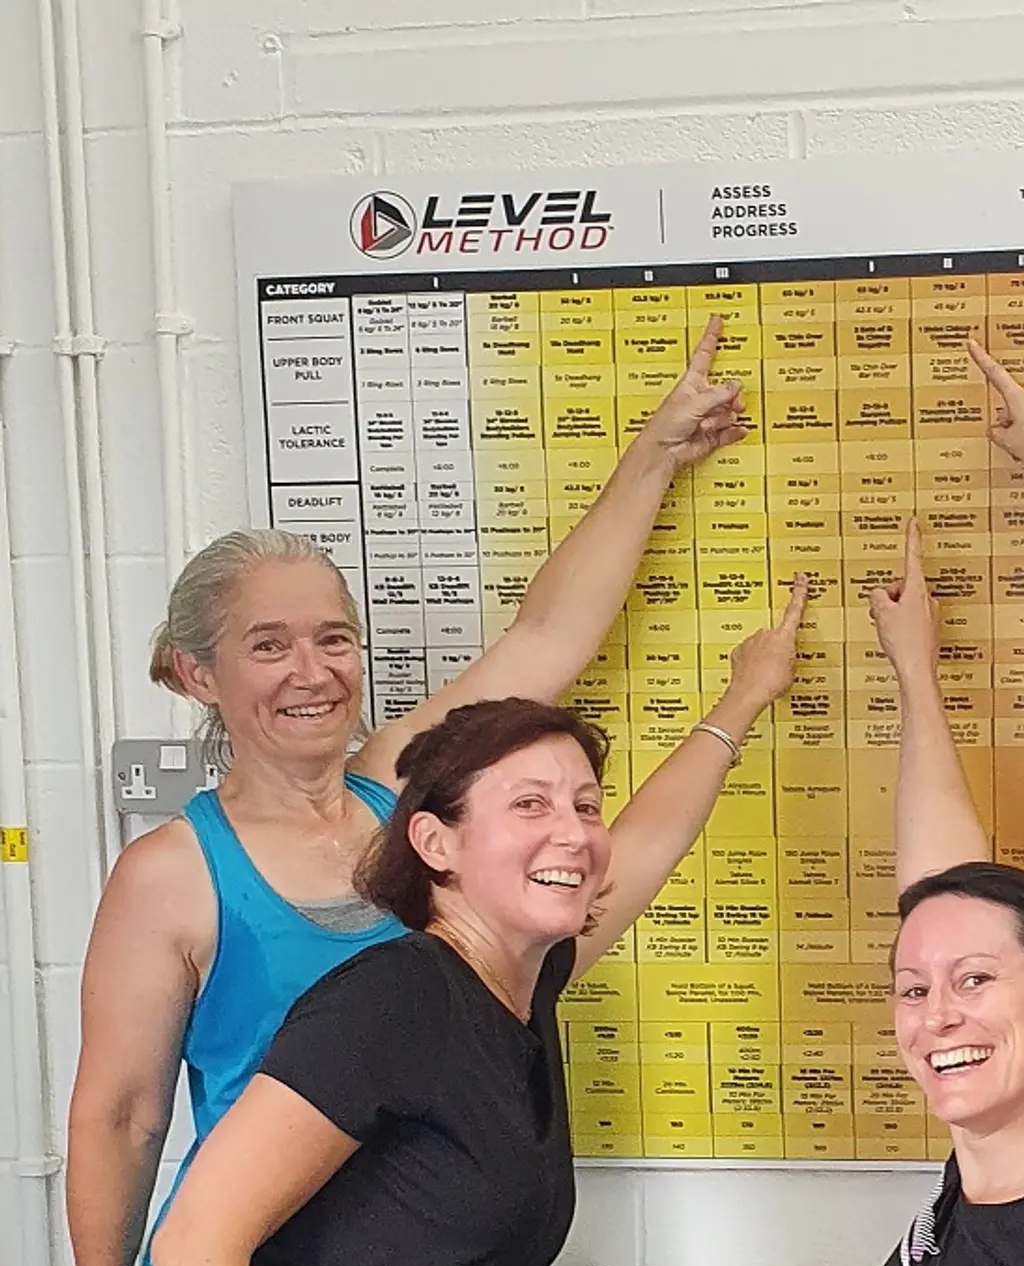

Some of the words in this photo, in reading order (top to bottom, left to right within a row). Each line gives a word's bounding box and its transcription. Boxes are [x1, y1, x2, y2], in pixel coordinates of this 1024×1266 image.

[712, 185, 770, 199] ASSESS
[422, 191, 612, 228] LEVEL
[712, 204, 786, 219] ADDRESS
[713, 223, 797, 238] PROGRESS
[416, 226, 608, 254] METHOD
[265, 282, 335, 296] CATEGORY
[268, 316, 306, 325] FRONT
[308, 314, 344, 324] SQUAT
[273, 358, 309, 367] UPPER
[312, 357, 342, 366] BODY
[295, 371, 321, 380] PULL
[292, 426, 331, 435] LACTIC
[279, 439, 346, 449] TOLERANCE
[288, 497, 342, 507] DEADLIFT
[320, 534, 350, 543] BODY
